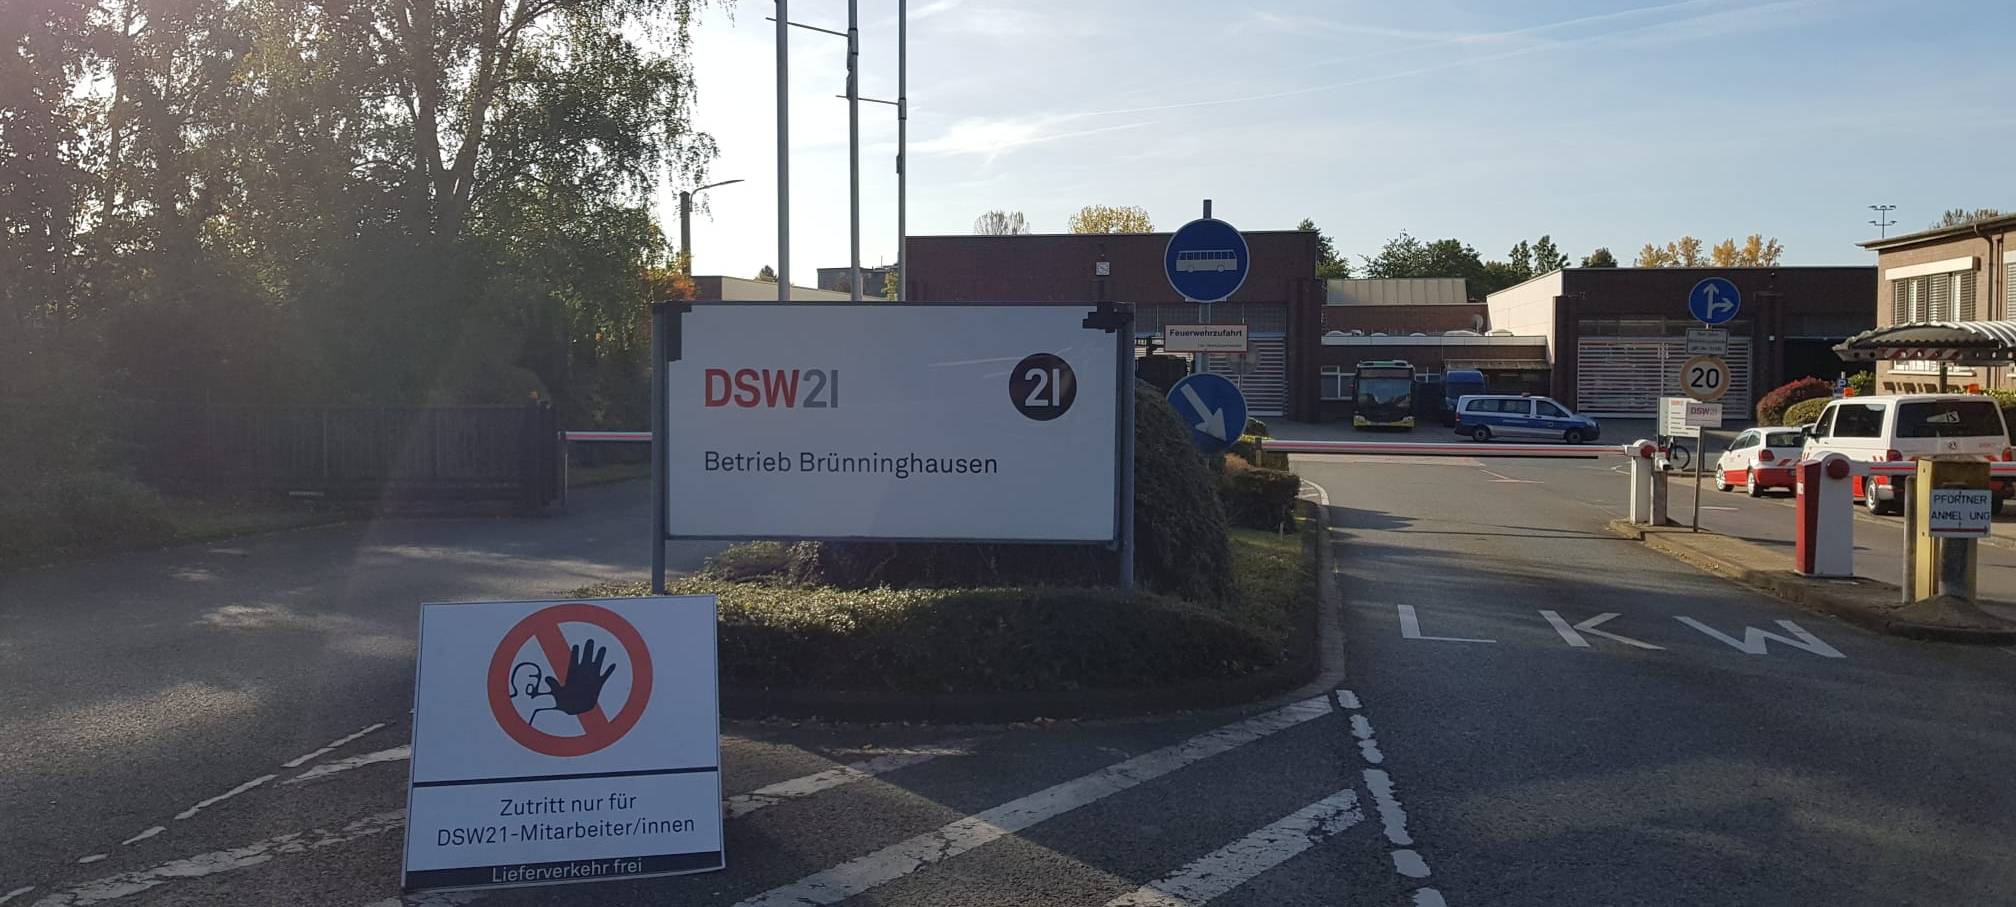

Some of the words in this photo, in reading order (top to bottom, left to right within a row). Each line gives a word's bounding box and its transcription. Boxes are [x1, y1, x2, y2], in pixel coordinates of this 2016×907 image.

[1169, 328, 1242, 337] Feuerwehrzufahrt
[705, 368, 839, 408] DSW21
[1024, 368, 1060, 407] 21
[1691, 367, 1719, 388] 20
[705, 451, 791, 472] Betrieb
[800, 451, 999, 479] Brünninghausen
[500, 797, 566, 816] Zutritt
[571, 798, 603, 813] nur
[609, 793, 637, 810] für
[437, 817, 696, 847] DSW21-Mitarbeiter/innen
[492, 860, 608, 883] Lieferverkehr
[613, 857, 642, 873] frei
